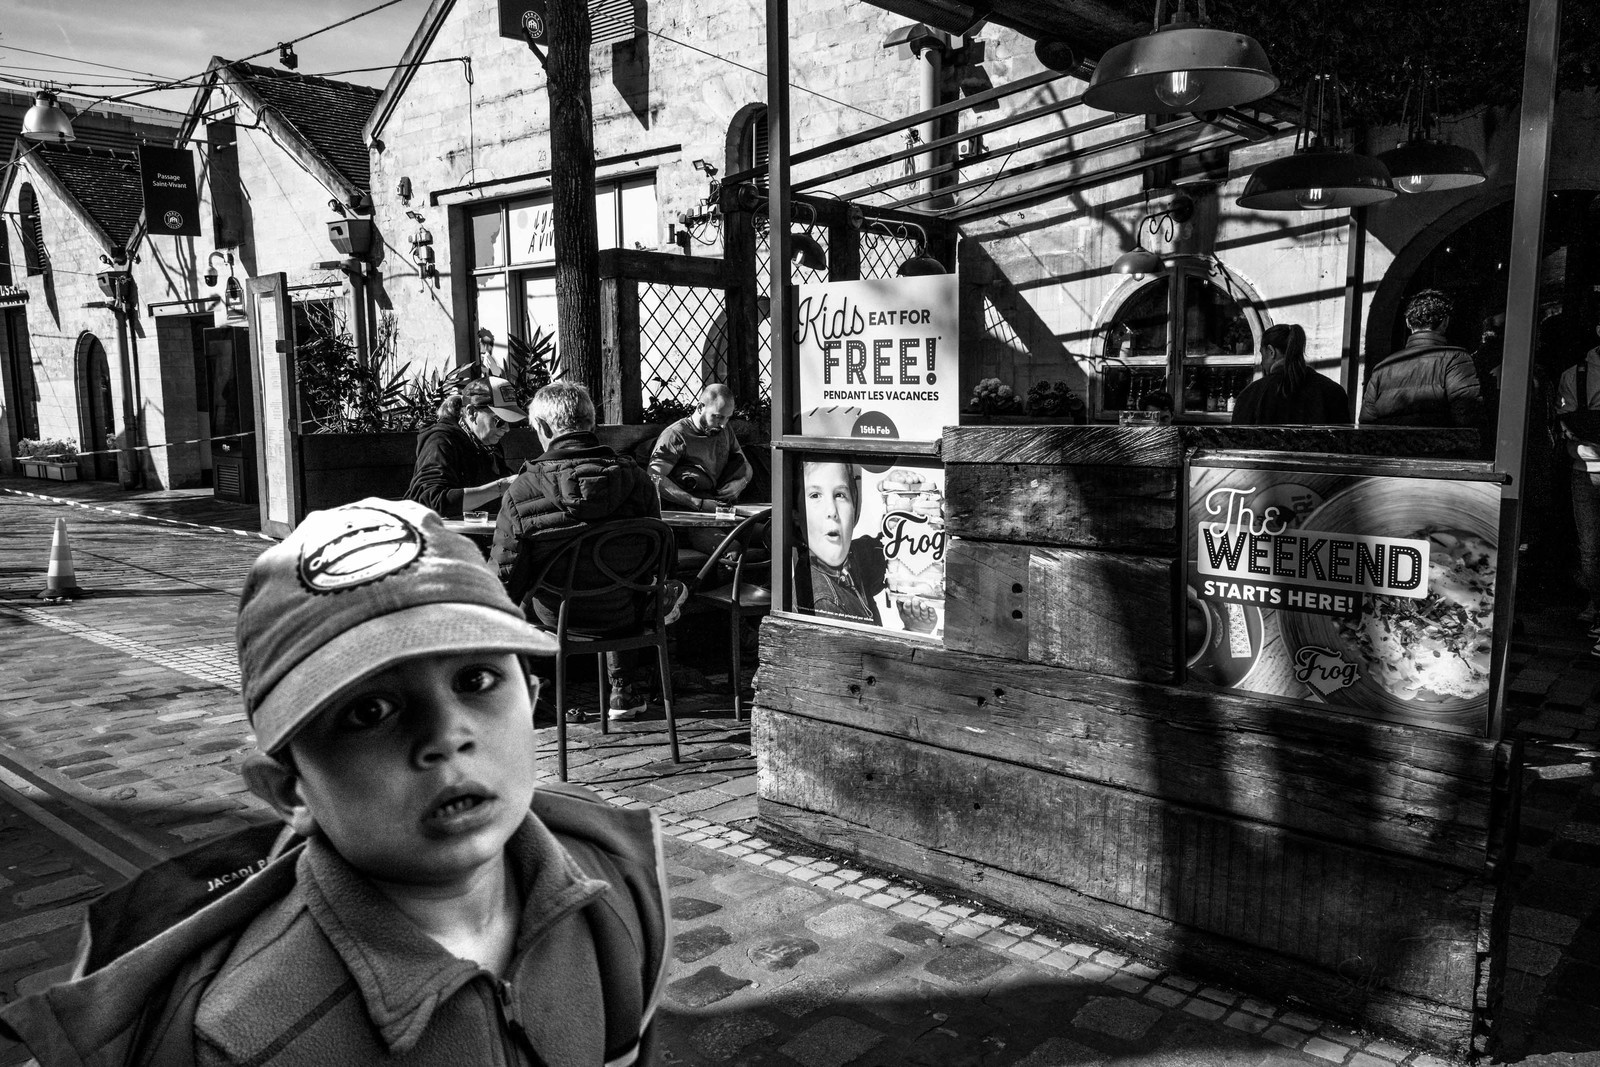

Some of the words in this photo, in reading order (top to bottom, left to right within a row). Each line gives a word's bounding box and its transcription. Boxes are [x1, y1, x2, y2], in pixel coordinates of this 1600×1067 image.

[537, 150, 547, 162] 23
[157, 173, 180, 181] Passage
[793, 293, 865, 351] Kids
[868, 311, 897, 326] EAT
[899, 309, 931, 325] FOR
[823, 337, 938, 386] FREE!
[823, 390, 867, 401] PENDANT
[868, 391, 884, 401] LES
[885, 391, 940, 401] VACANCES
[859, 425, 875, 434] 15th
[876, 425, 891, 435] Feb
[1205, 486, 1288, 539] The
[882, 511, 945, 561] Frog
[1202, 527, 1423, 591] WEEKEND
[1203, 579, 1283, 605] STARTS
[1287, 589, 1355, 613] HERE!
[1295, 646, 1359, 688] Frog
[207, 866, 254, 892] JACADI
